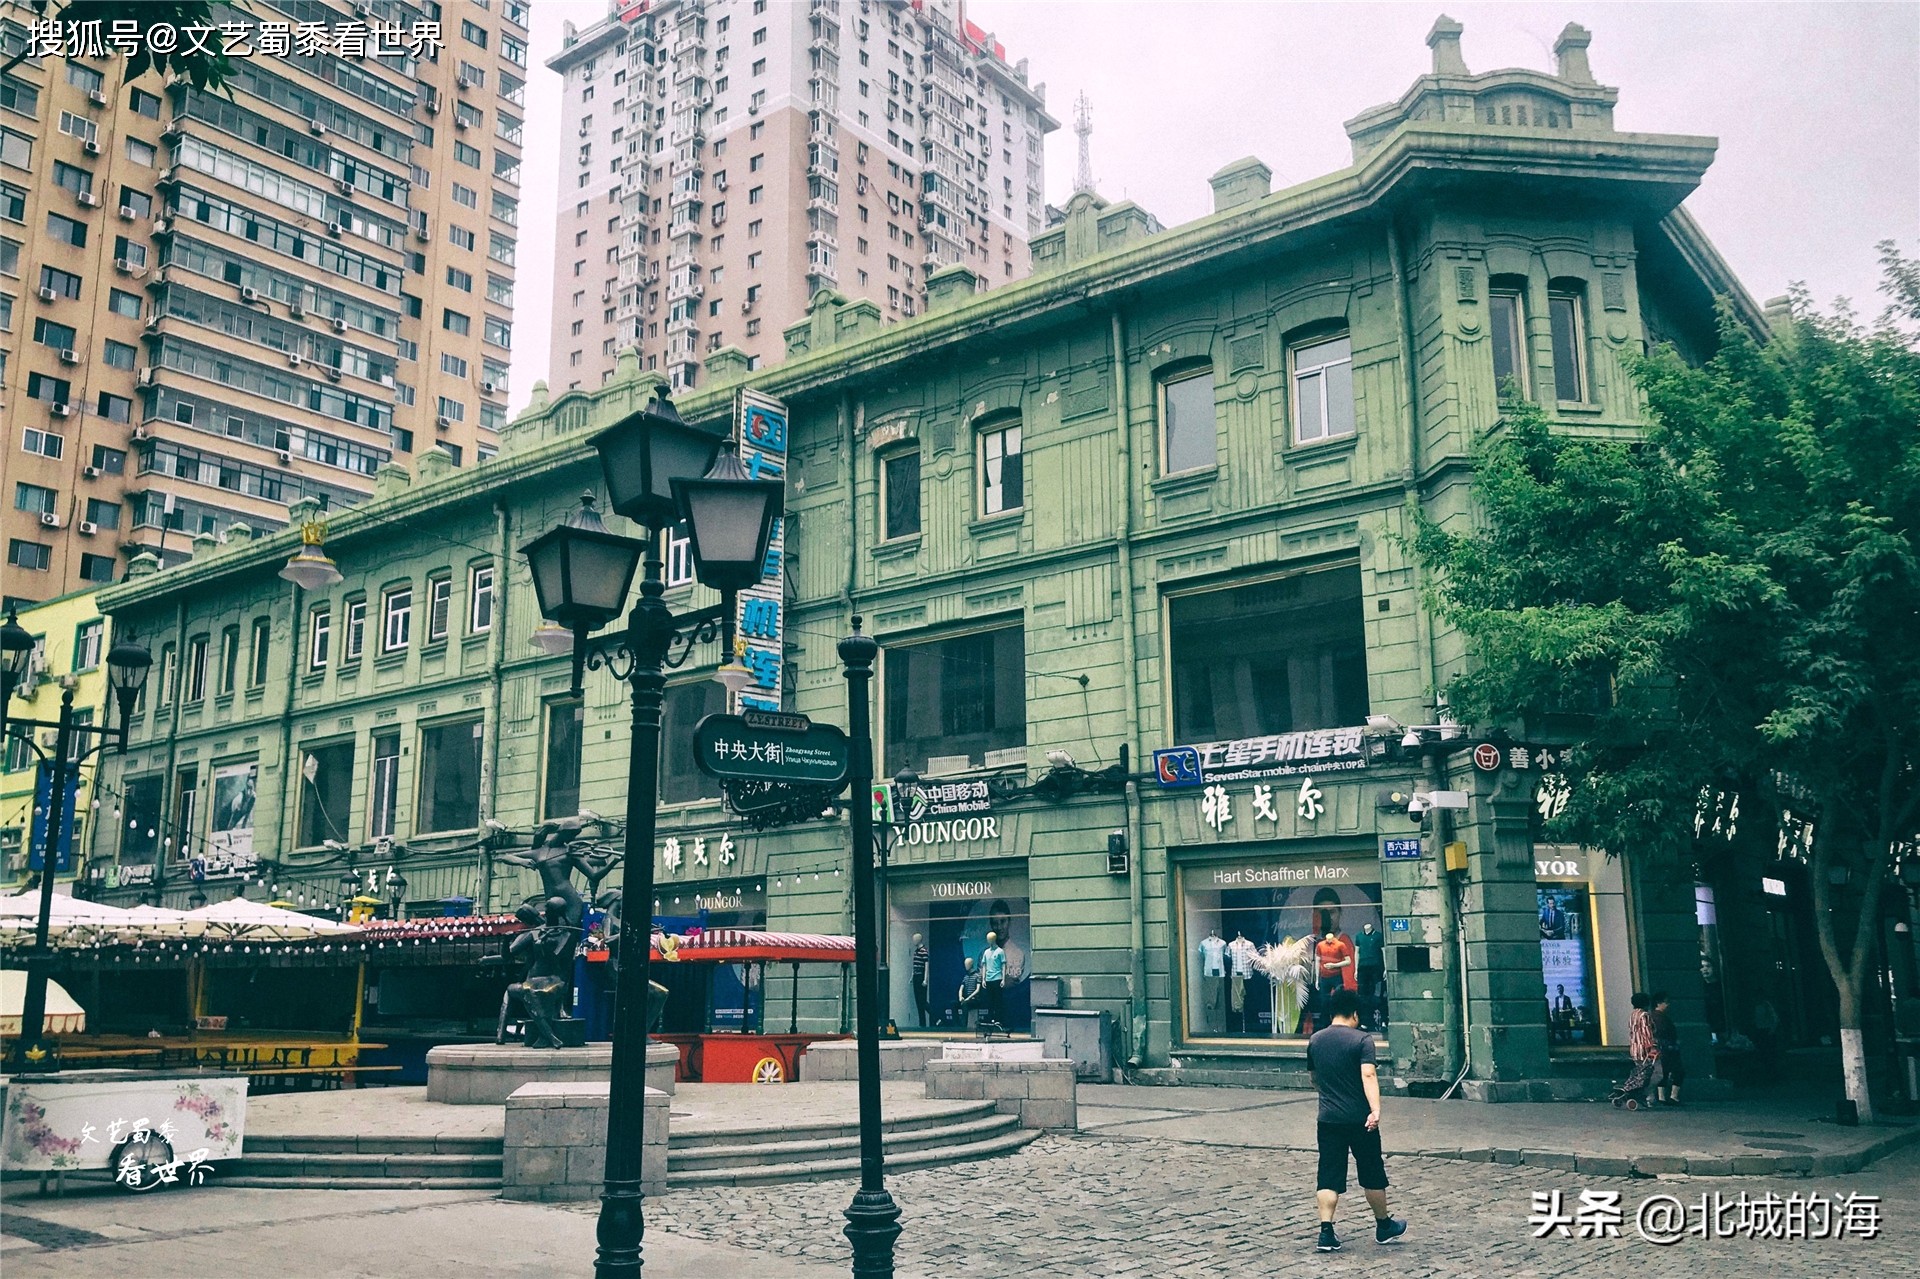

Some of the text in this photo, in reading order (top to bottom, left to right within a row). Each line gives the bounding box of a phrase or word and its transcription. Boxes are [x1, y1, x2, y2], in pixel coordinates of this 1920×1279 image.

[714, 738, 781, 763] 中央大街
[1201, 728, 1363, 769] 七星手机连锁
[1204, 769, 1261, 783] SevenStar
[1262, 764, 1296, 777] mobile
[927, 780, 988, 803] 中国移动
[930, 799, 991, 815] China Mobile
[1201, 777, 1325, 833] 雅戈尔
[892, 816, 1000, 847] YOUNGOR
[663, 832, 736, 874] 雅戈尔
[1213, 864, 1350, 884] Hart Schaffner Marx
[931, 882, 993, 897] YOUNGOR
[693, 895, 744, 911] YOUNGOR
